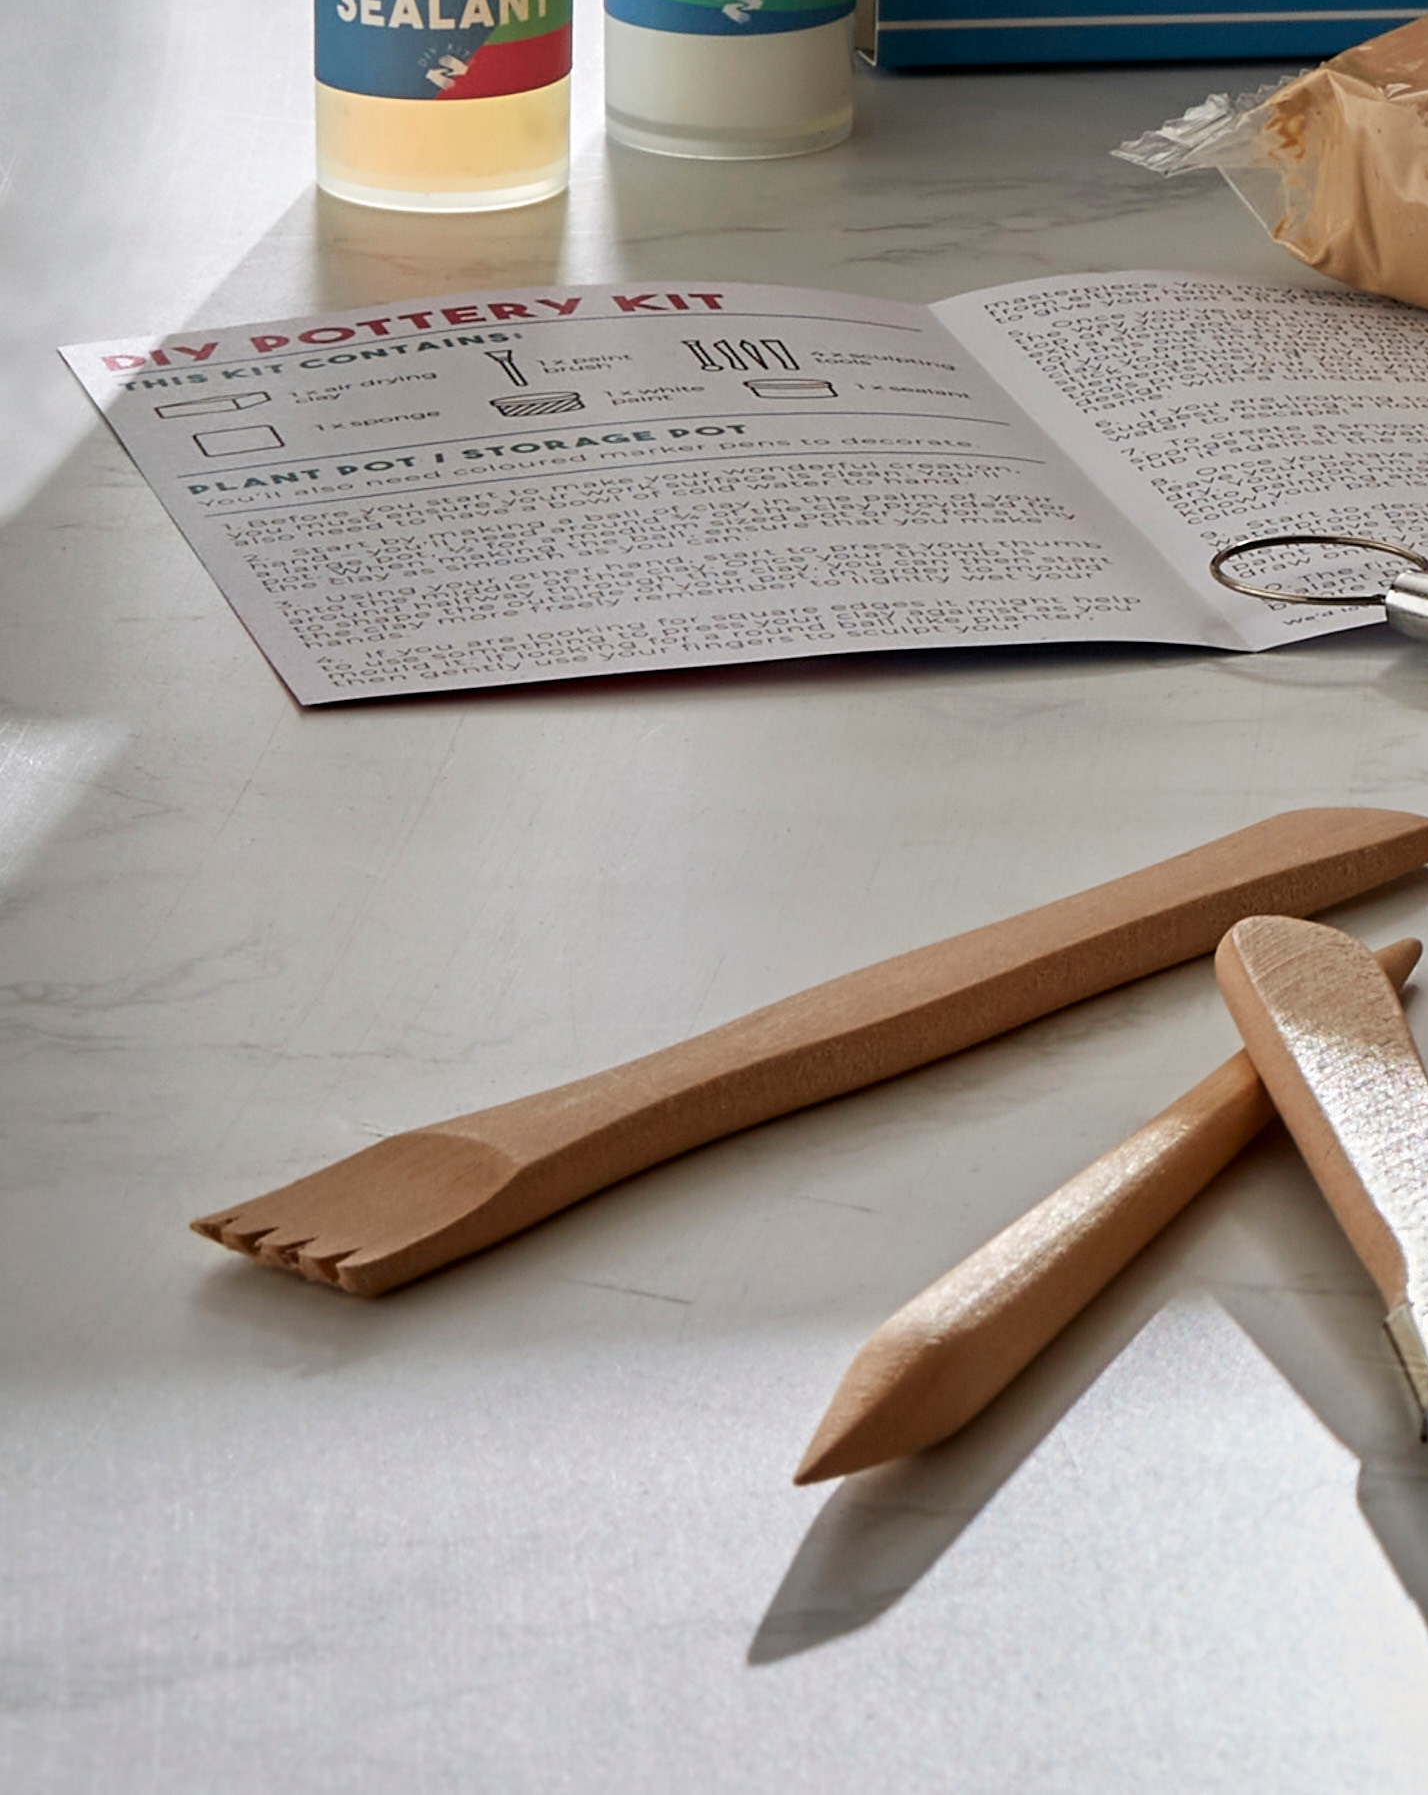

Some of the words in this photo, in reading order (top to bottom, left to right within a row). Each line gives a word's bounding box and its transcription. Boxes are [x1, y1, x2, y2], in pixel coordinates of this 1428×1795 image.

[100, 341, 219, 372] DIY
[250, 297, 582, 353] POTTERY
[612, 293, 725, 313] KIT
[117, 373, 209, 392] THIS
[221, 363, 285, 380] KIT
[299, 332, 523, 369] CONTAINS:
[541, 361, 613, 374] brush
[572, 353, 632, 366] paint
[813, 356, 872, 366] tools
[844, 352, 956, 372] sculpting
[323, 381, 353, 393] air
[359, 371, 438, 389] drying
[633, 383, 706, 396] white
[889, 385, 972, 400] sealant
[295, 391, 343, 405] clay
[611, 394, 672, 406] paint
[348, 410, 441, 432] sponge
[188, 469, 320, 495] PLANT
[336, 456, 416, 476] POT
[461, 430, 657, 460] STORAGE
[668, 424, 747, 438] POT
[197, 490, 282, 506] You'll
[295, 483, 354, 497] also
[366, 470, 441, 487] need
[453, 454, 587, 476] coloured
[600, 443, 705, 459] marker
[719, 440, 790, 451] pens
[800, 437, 830, 446] to
[248, 511, 350, 528] Before
[360, 503, 415, 515] you
[426, 492, 498, 505] start
[509, 487, 539, 497] to
[552, 476, 634, 492] make
[644, 468, 711, 484] your
[721, 462, 878, 476] wonderful
[227, 527, 282, 541] you
[296, 516, 375, 530] must
[386, 501, 491, 519] ensure
[501, 492, 568, 506] your
[581, 483, 655, 497] work
[666, 474, 776, 489] surface
[234, 533, 295, 548] also
[307, 522, 384, 538] need
[396, 518, 427, 527] to
[438, 507, 508, 522] have
[550, 495, 622, 509] bowl
[672, 484, 736, 497] cold
[746, 478, 829, 490] water
[843, 477, 873, 486] to
[428, 520, 545, 539] making
[584, 509, 641, 521] ball
